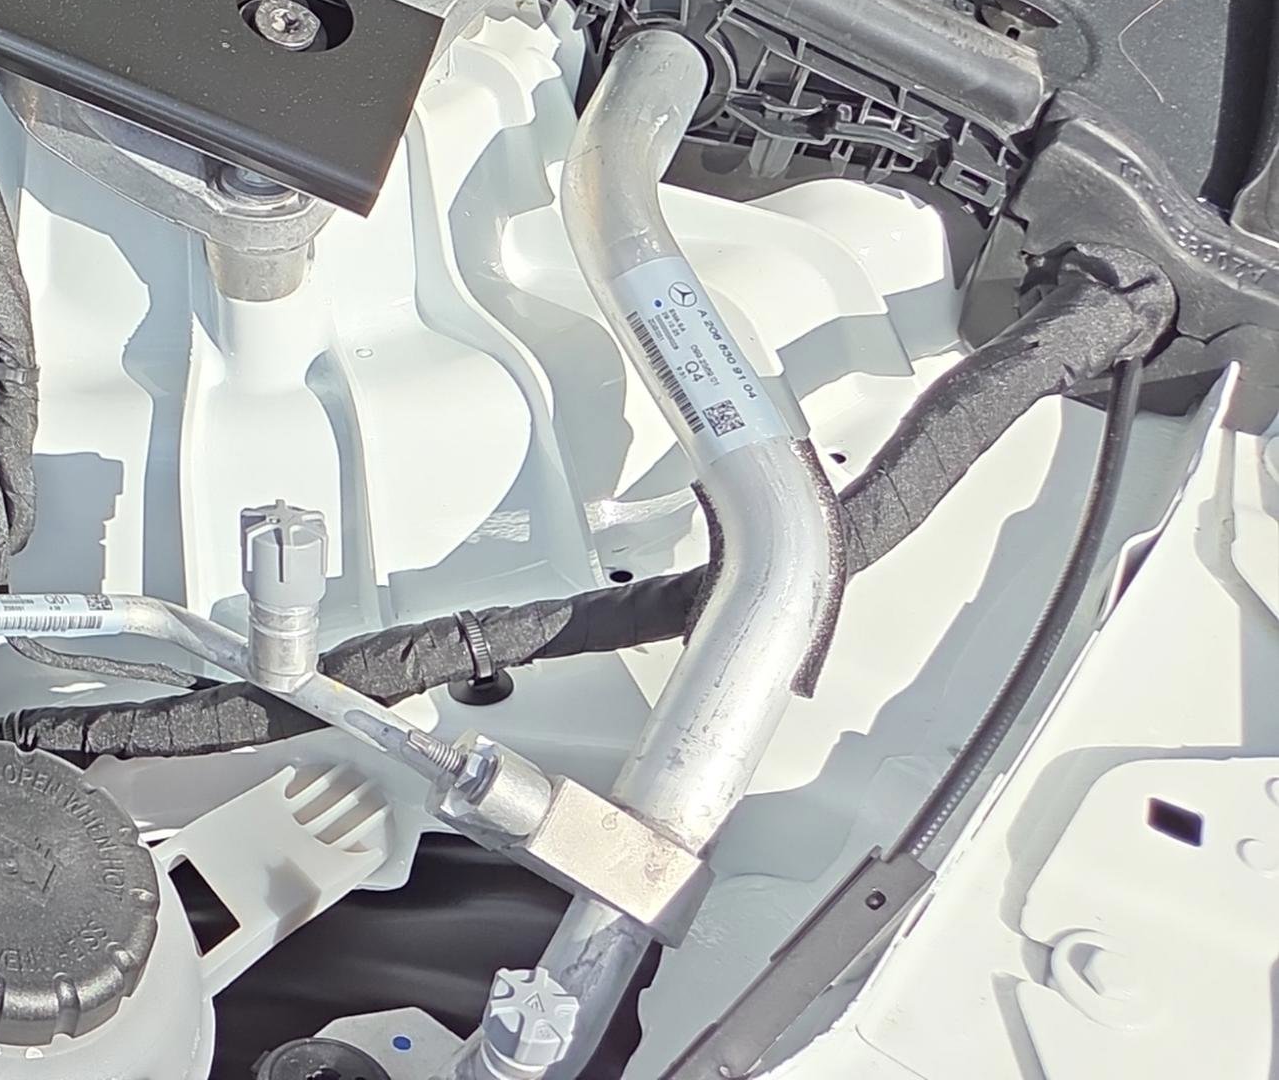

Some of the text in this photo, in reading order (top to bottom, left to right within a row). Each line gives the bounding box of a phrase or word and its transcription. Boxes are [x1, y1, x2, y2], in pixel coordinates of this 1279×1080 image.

[684, 360, 705, 383] Q4
[742, 383, 758, 400] 04
[2, 764, 63, 797] OPEN
[63, 786, 113, 855] WHEN
